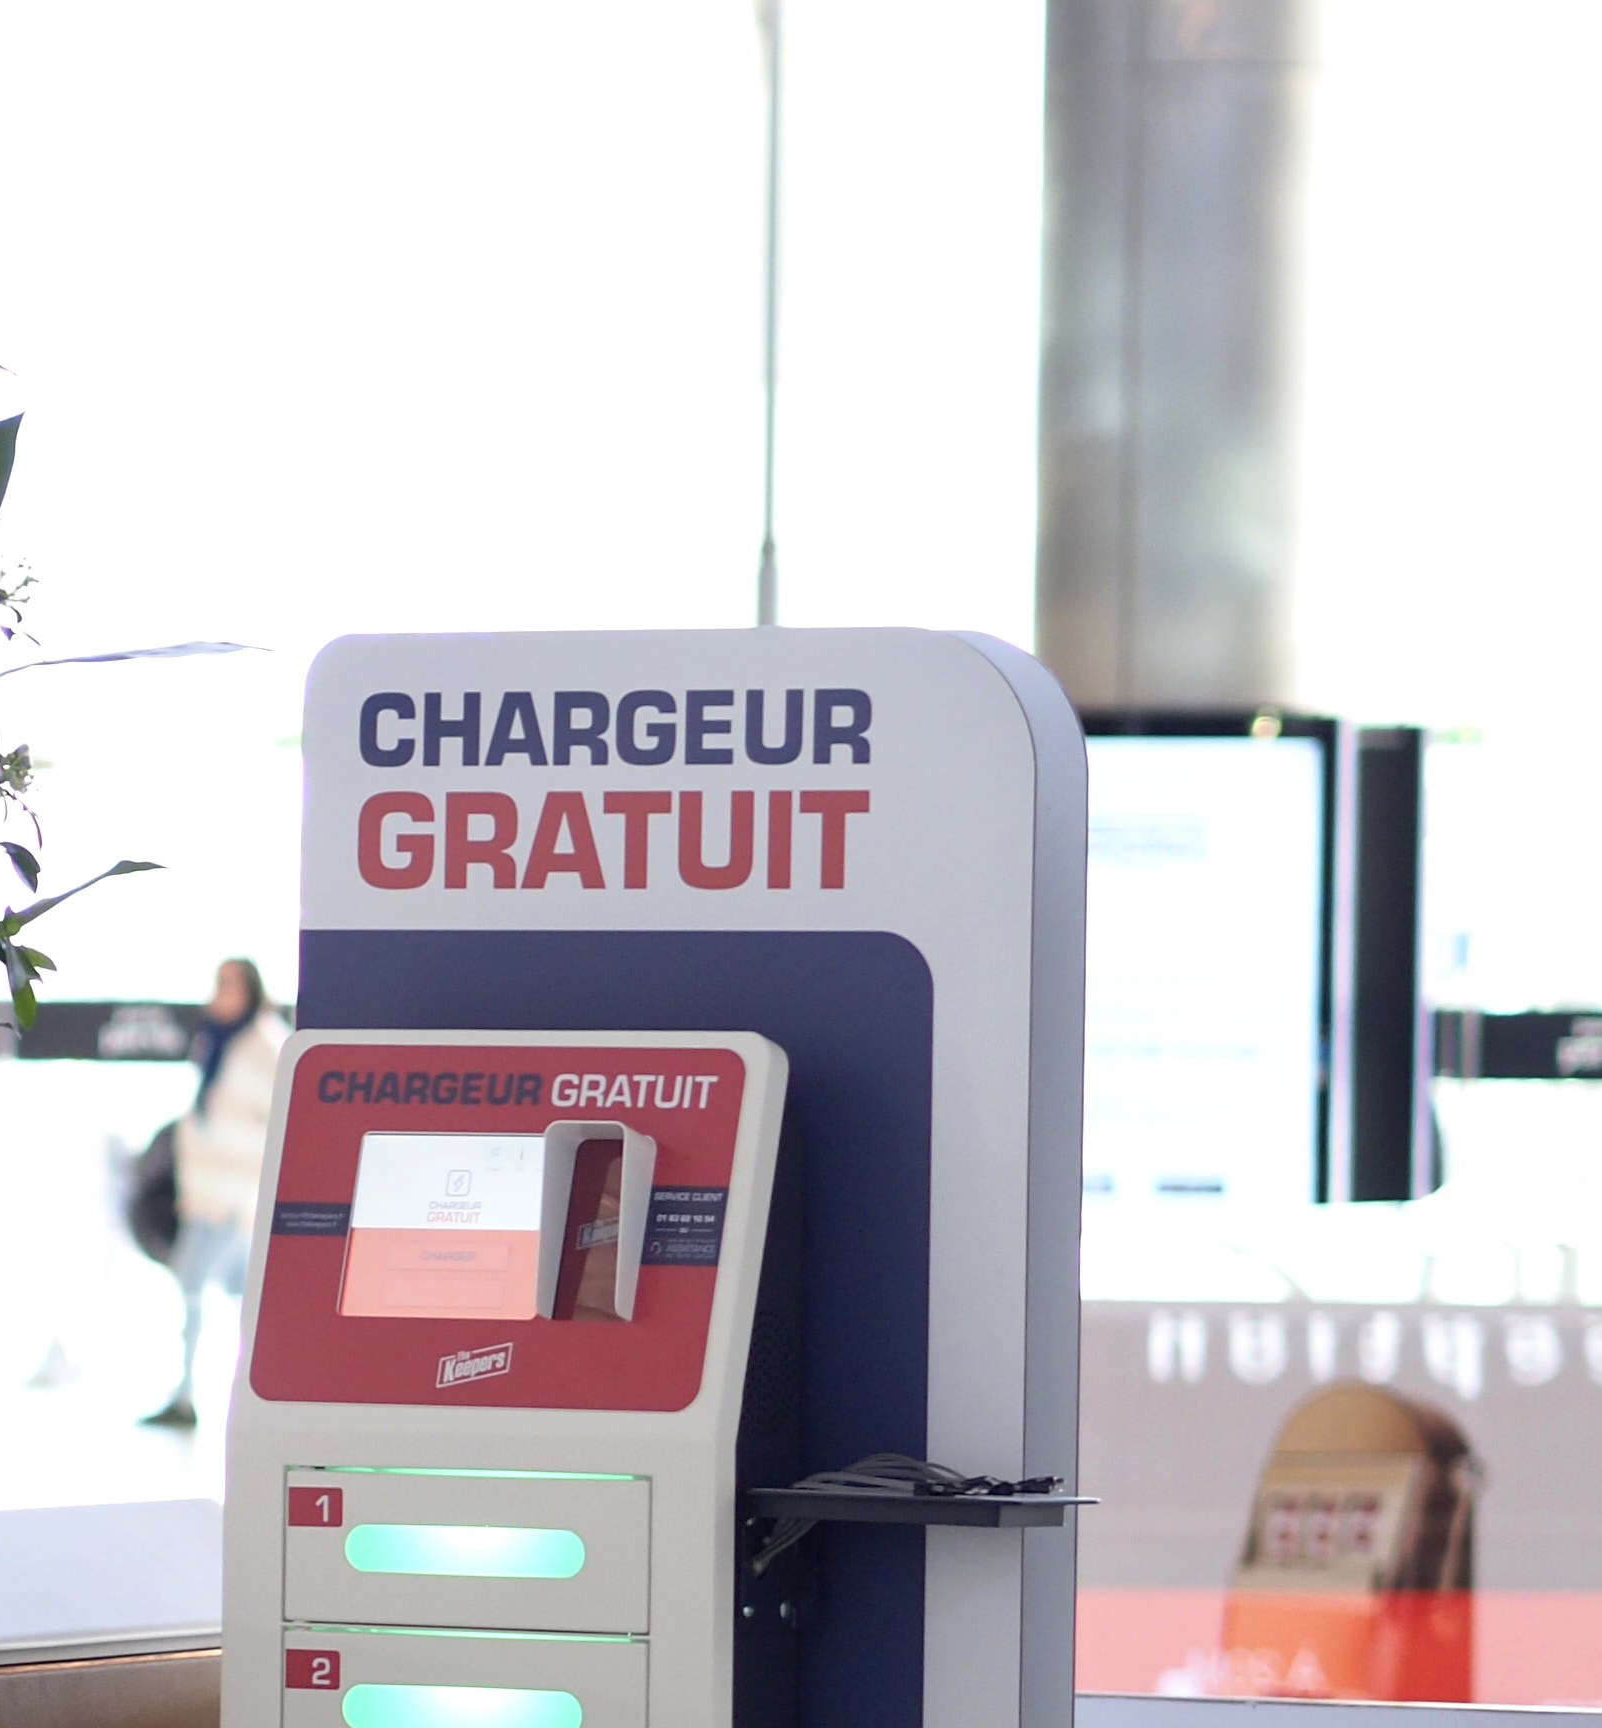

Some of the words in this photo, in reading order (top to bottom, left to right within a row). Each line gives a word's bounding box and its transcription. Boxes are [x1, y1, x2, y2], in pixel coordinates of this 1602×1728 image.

[359, 687, 873, 768] CHARGEUR
[357, 789, 871, 891] GRATUIT
[317, 1070, 543, 1106] CHARGEUR
[551, 1073, 719, 1110] GRATUIT
[428, 1200, 483, 1211] CHARGEUR
[653, 1191, 690, 1202] SERVICE
[692, 1192, 724, 1202] CLIENT
[425, 1211, 482, 1225] GRATUIT
[442, 1351, 507, 1383] Keepers
[312, 1494, 332, 1523] 1
[310, 1657, 332, 1686] 2
